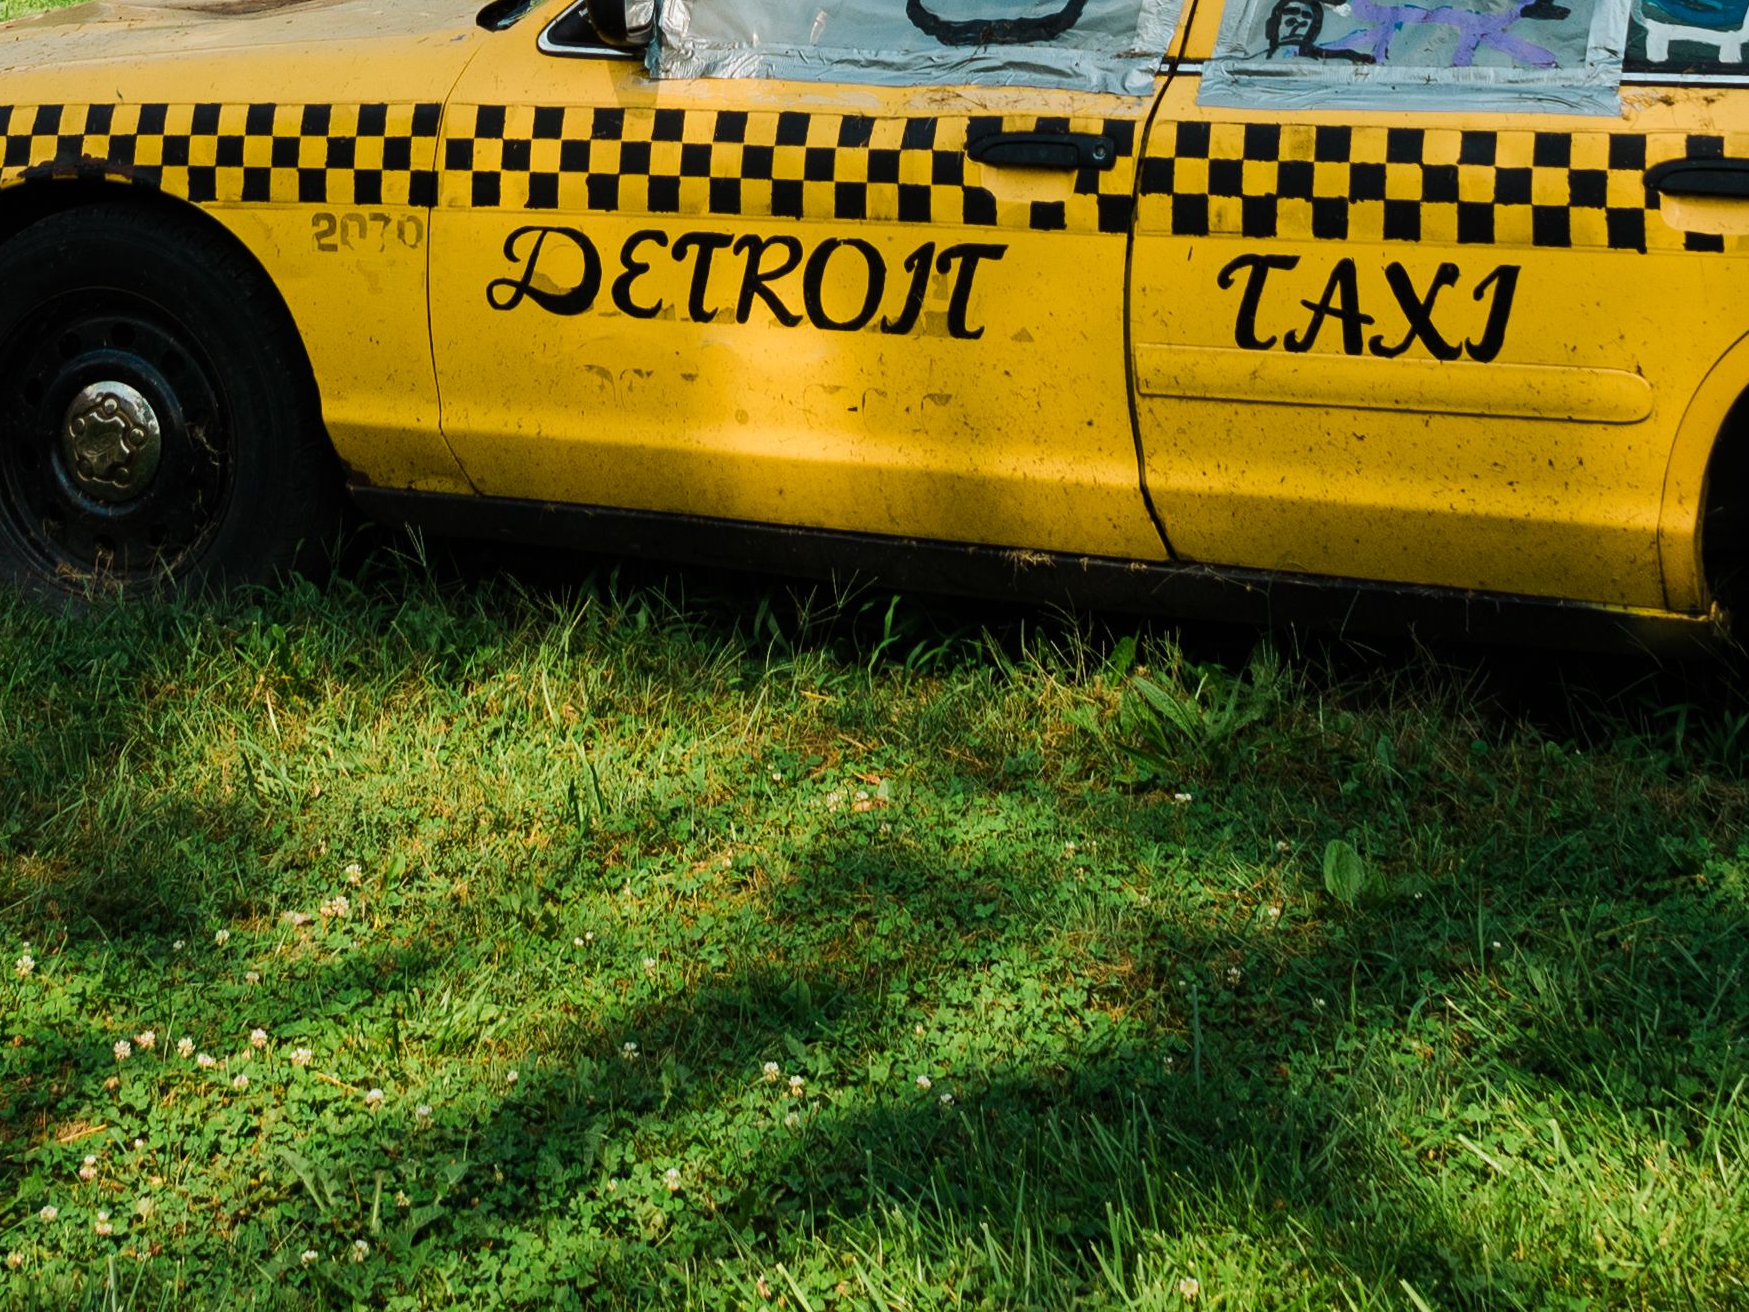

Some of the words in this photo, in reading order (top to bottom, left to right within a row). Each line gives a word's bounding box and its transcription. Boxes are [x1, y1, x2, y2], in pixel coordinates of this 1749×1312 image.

[312, 212, 424, 253] 2070
[486, 225, 1009, 340] DETROIT
[1216, 253, 1522, 364] TAXI
